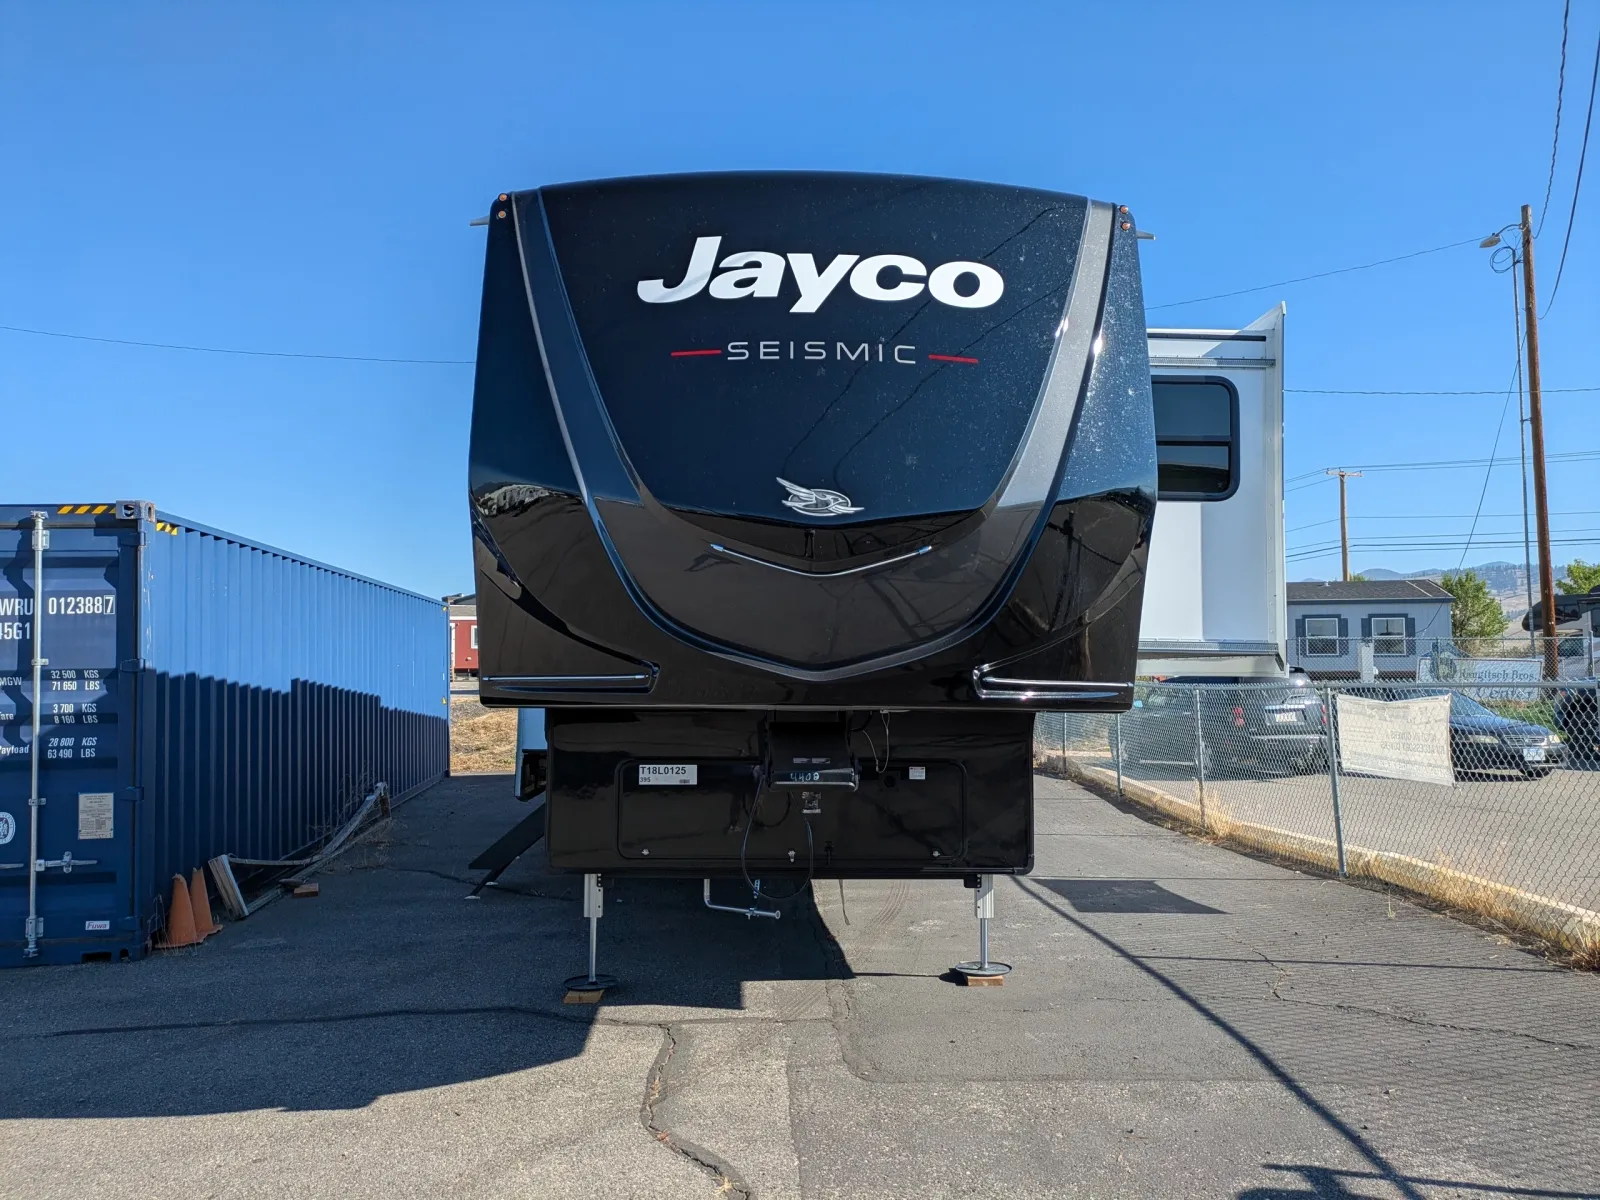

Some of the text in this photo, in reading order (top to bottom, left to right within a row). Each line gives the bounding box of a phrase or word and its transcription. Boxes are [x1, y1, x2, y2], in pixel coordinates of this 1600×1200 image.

[636, 236, 1004, 313] Jayco
[727, 341, 916, 364] SEISMIC
[48, 596, 115, 615] 0123887
[0, 622, 30, 640] 5G1
[51, 670, 99, 679] 32 500 KGS
[1512, 670, 1537, 681] Bros.
[0, 677, 22, 686] MGW
[52, 681, 100, 690] 71 650 LBS
[53, 704, 97, 713] 3 700 KGS
[62, 715, 75, 724] 160
[83, 715, 98, 723] LBS
[48, 737, 97, 747] 28 800 KGS
[47, 748, 96, 759] 63 490 LBS
[640, 766, 687, 776] T18L0125
